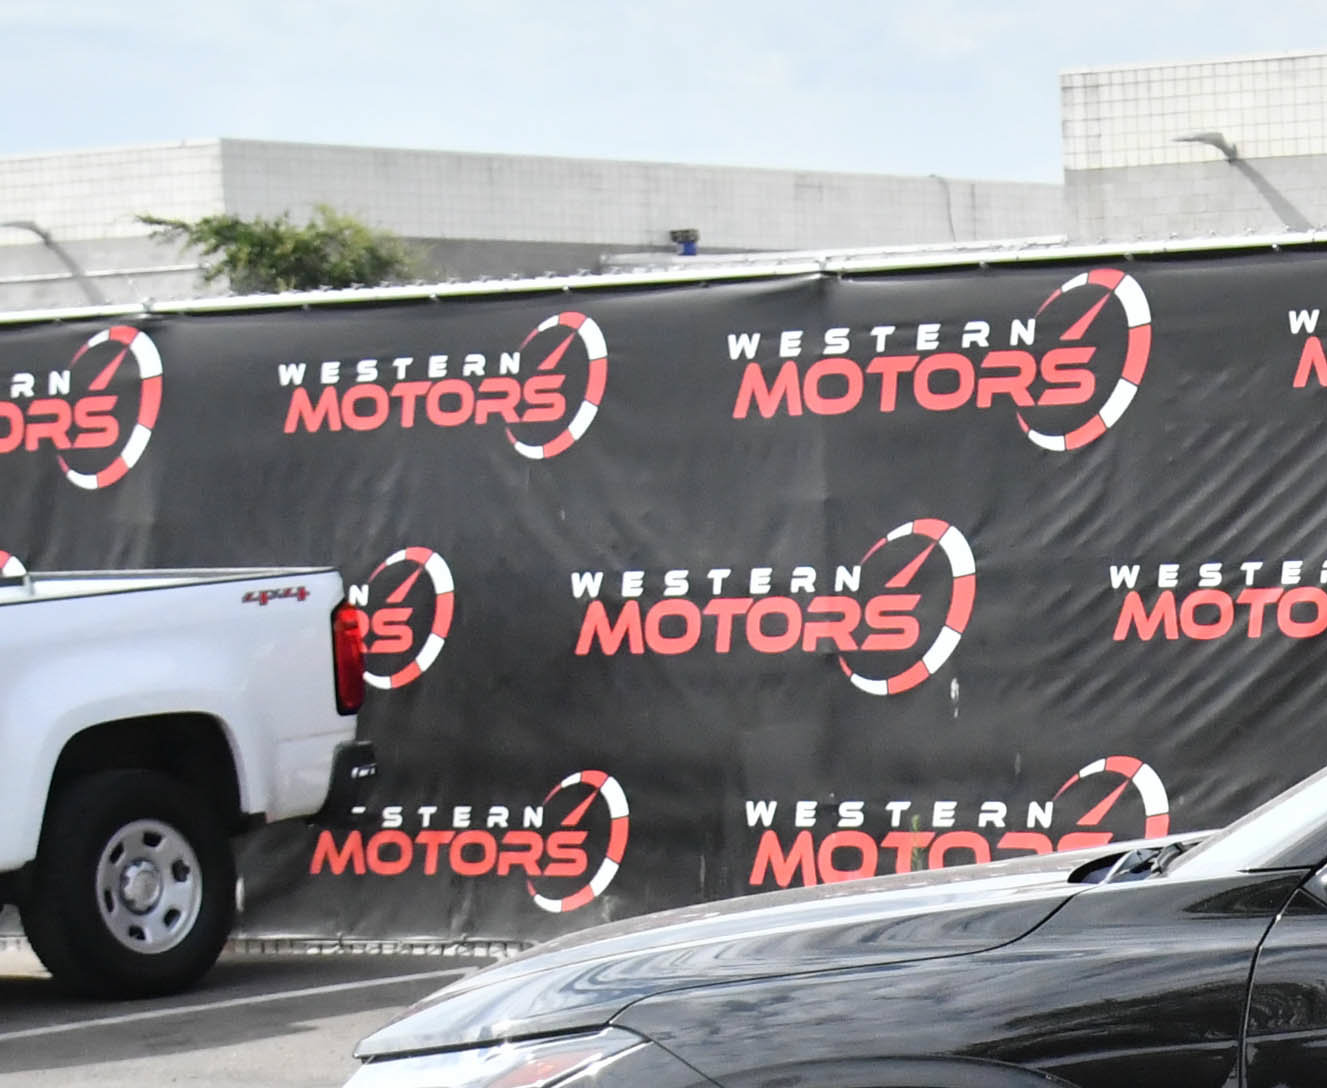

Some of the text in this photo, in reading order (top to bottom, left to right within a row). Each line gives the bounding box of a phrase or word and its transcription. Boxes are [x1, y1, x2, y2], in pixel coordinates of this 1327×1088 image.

[727, 318, 1036, 361] WESTERN
[278, 351, 521, 386] WESTERN
[732, 346, 1098, 419] MOTORS
[284, 373, 567, 434] MOTORS
[570, 565, 862, 598] WESTERN
[574, 593, 922, 656] MOTORS
[352, 806, 544, 828] STERN
[745, 800, 1054, 829] WESTERN
[310, 829, 588, 878] MOTORS
